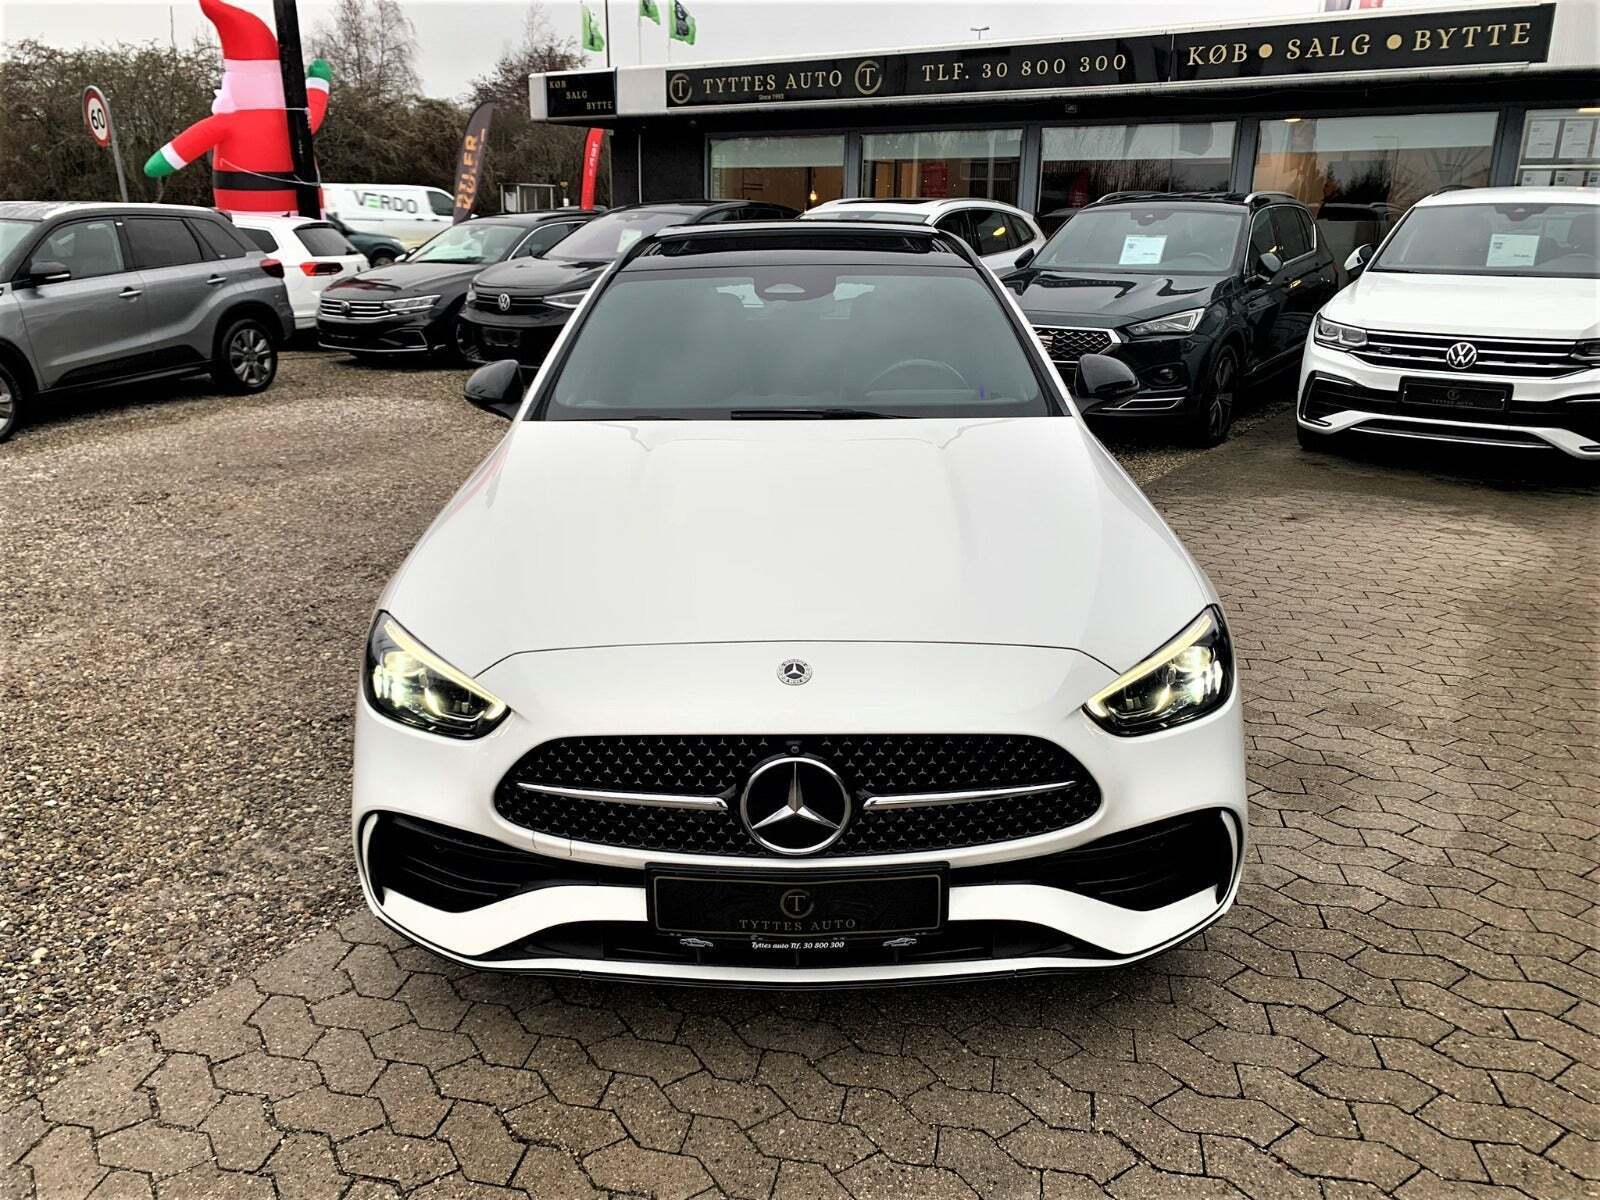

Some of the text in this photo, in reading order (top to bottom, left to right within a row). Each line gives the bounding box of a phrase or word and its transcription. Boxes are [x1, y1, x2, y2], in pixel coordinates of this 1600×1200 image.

[1187, 22, 1531, 66] KØB SALG BYTTE
[921, 54, 1126, 82] TLF. 30 800 300
[703, 70, 842, 93] TYTTES AUTO
[566, 91, 588, 99] SALG
[586, 101, 613, 110] BYTTE
[91, 108, 105, 130] 60
[353, 190, 418, 214] VERDO
[739, 918, 856, 931] TYTTES AUTO
[751, 941, 771, 950] Tyttes
[829, 941, 845, 949] 300
